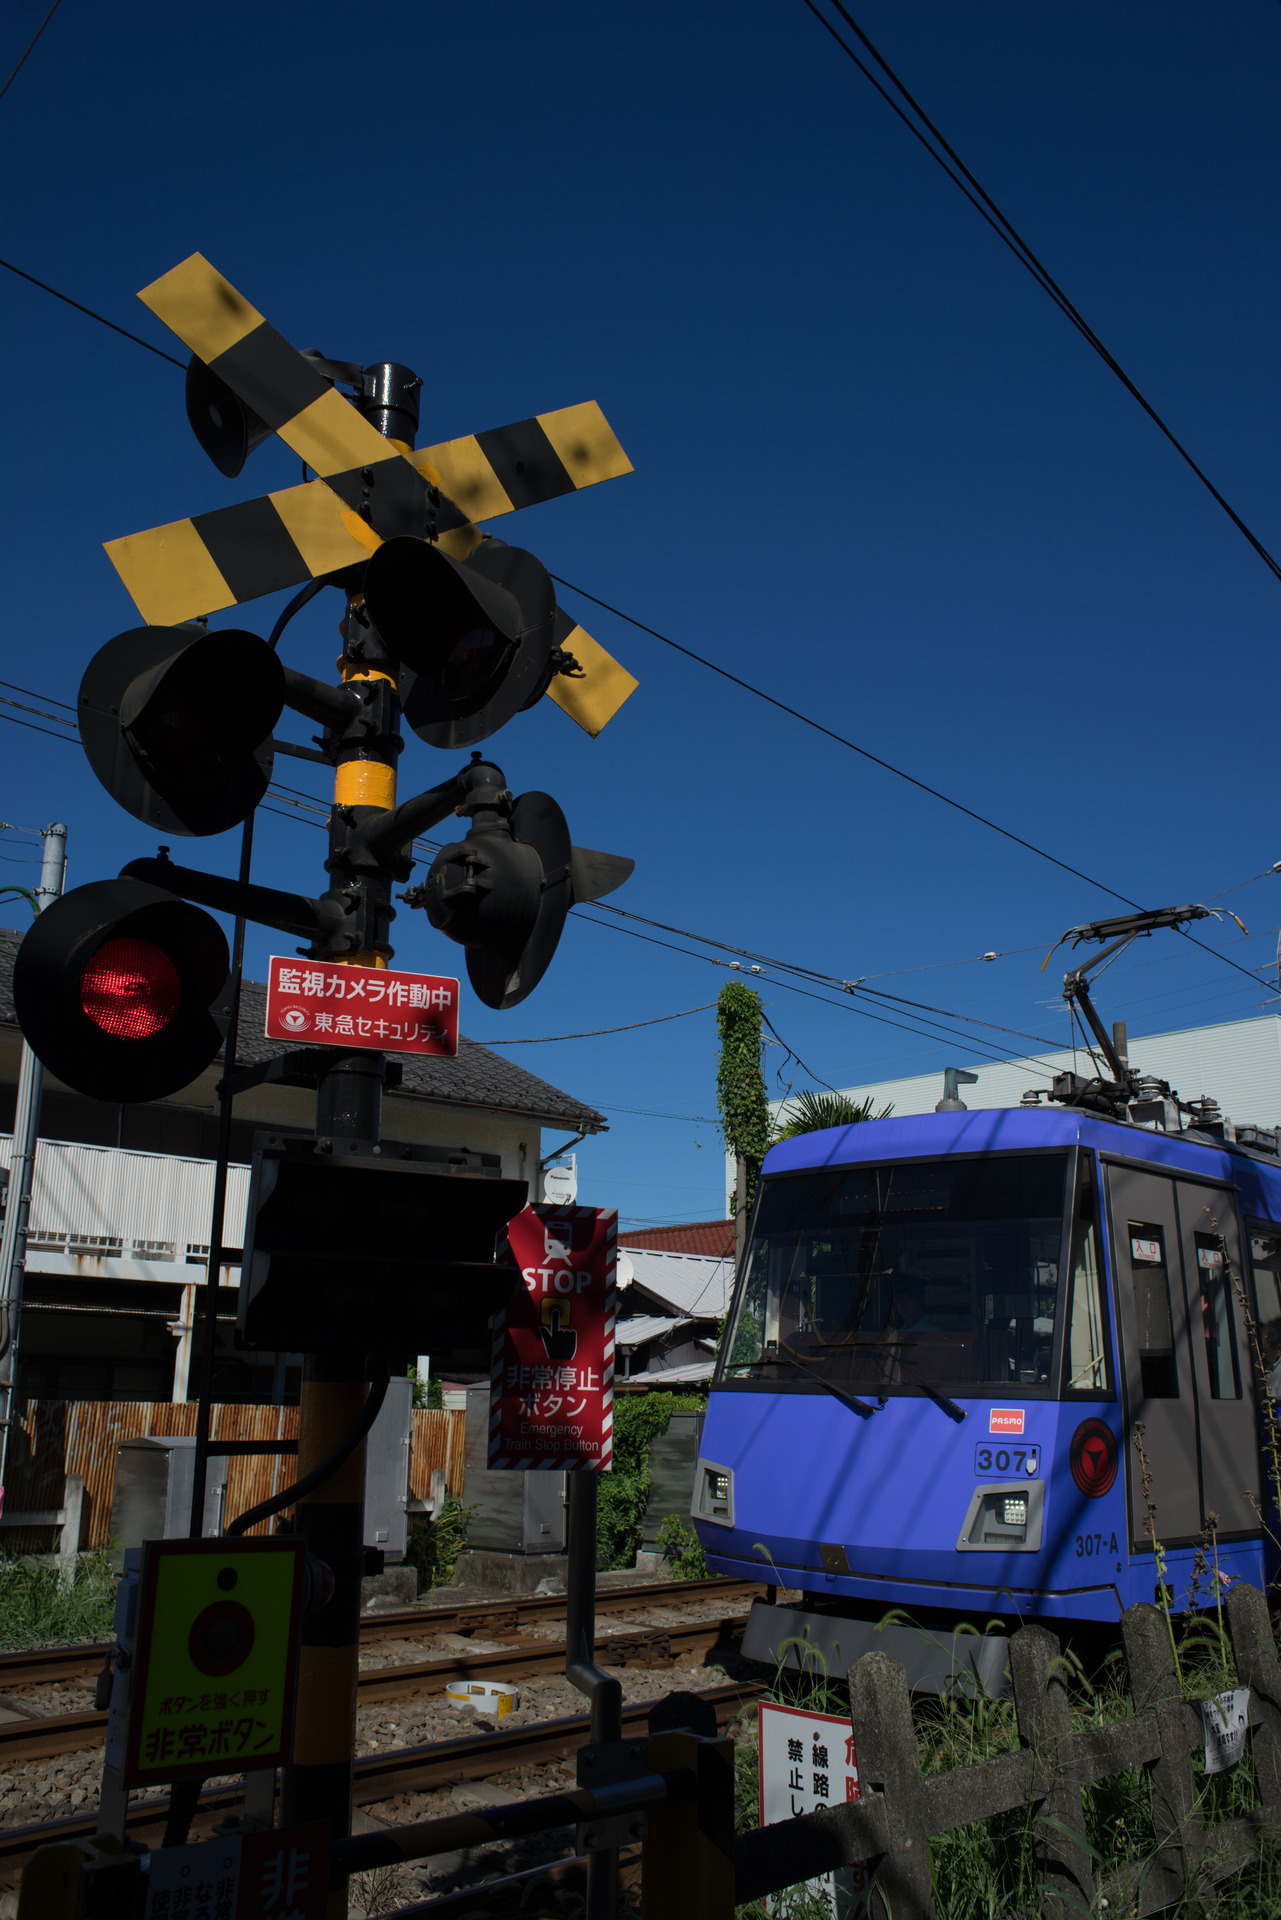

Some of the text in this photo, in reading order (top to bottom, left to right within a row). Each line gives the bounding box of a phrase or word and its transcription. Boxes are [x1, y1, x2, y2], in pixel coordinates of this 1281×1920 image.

[277, 967, 452, 1012] 監視カメラ作動中
[314, 1012, 448, 1045] 東急セキュリティ
[1136, 1240, 1156, 1254] 入口
[1201, 1249, 1219, 1263] 入口
[521, 1267, 592, 1294] STOP
[506, 1365, 600, 1391] 非常停止
[518, 1393, 587, 1418] ボタン
[520, 1422, 583, 1437] Emergency
[991, 1417, 1022, 1425] PASMO
[504, 1437, 599, 1453] Train Stop Button
[977, 1449, 1027, 1472] 307
[1075, 1531, 1119, 1557] 307-A
[159, 1688, 271, 1715] ボタンを強く押す
[145, 1718, 274, 1762] 非常ボタン
[260, 1847, 311, 1920] 非
